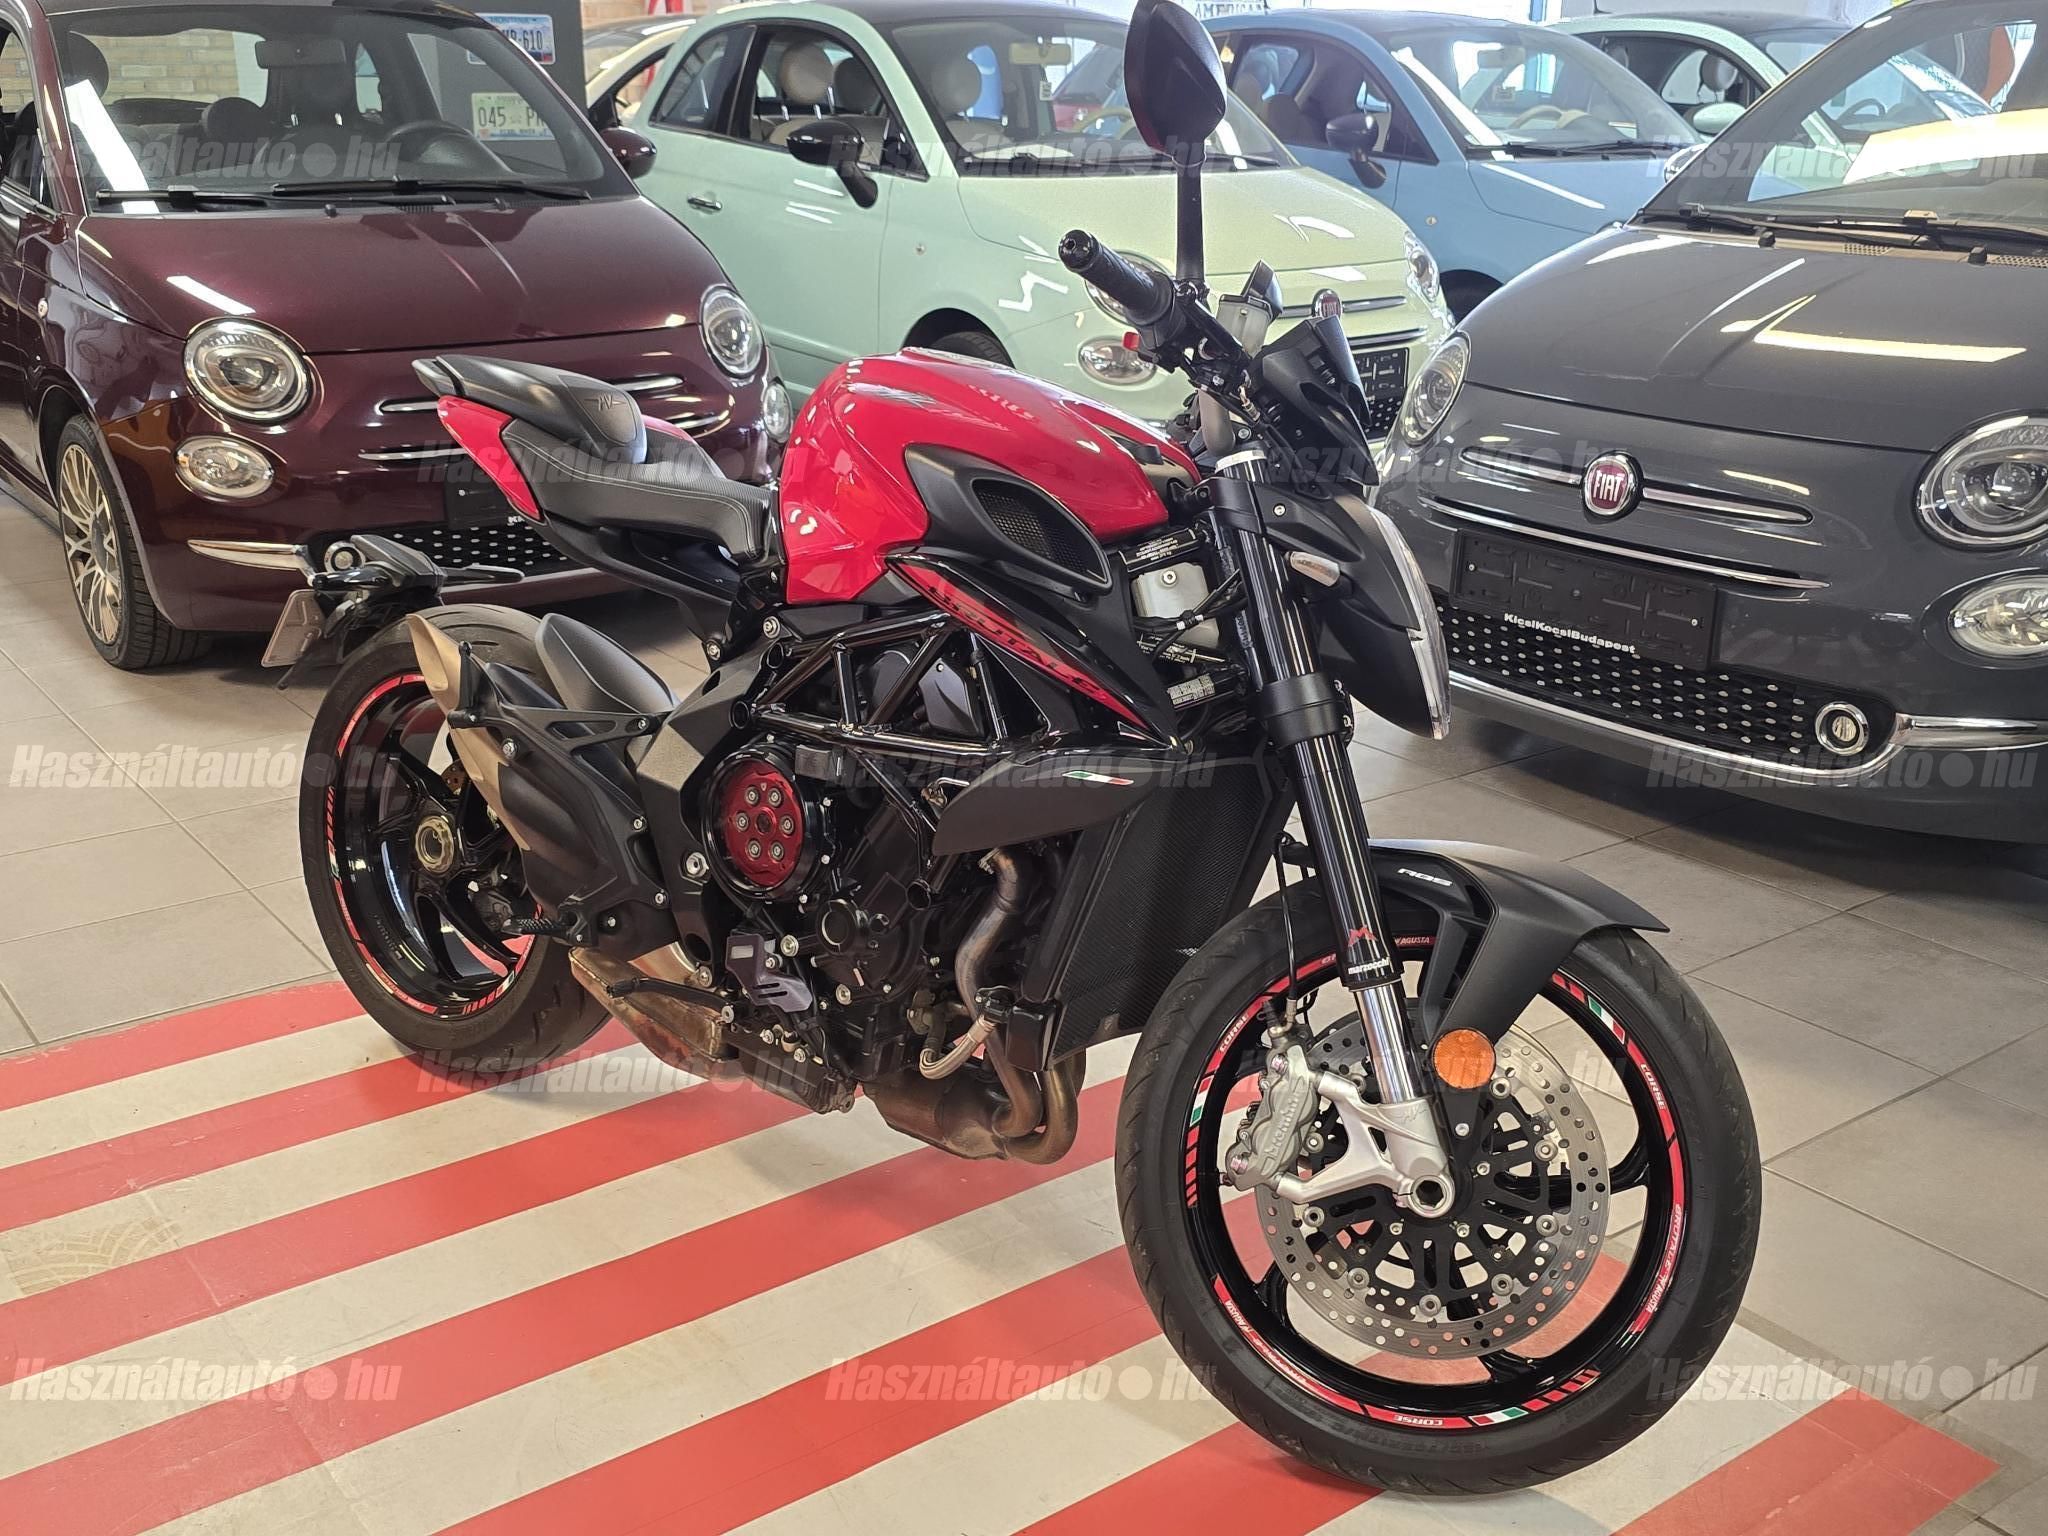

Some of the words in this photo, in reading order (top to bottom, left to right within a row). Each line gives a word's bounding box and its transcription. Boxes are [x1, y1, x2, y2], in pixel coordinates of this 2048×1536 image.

[478, 106, 506, 128] 045
[1593, 469, 1625, 502] FIAT
[1219, 1012, 1249, 1053] CORSE
[1640, 1063, 1666, 1110] CORSE
[1664, 1203, 1682, 1270] BRUTALE
[1644, 1284, 1665, 1314] AGUSTA
[1223, 1300, 1247, 1330] AGUSTA
[1393, 1414, 1443, 1426] CORSE
